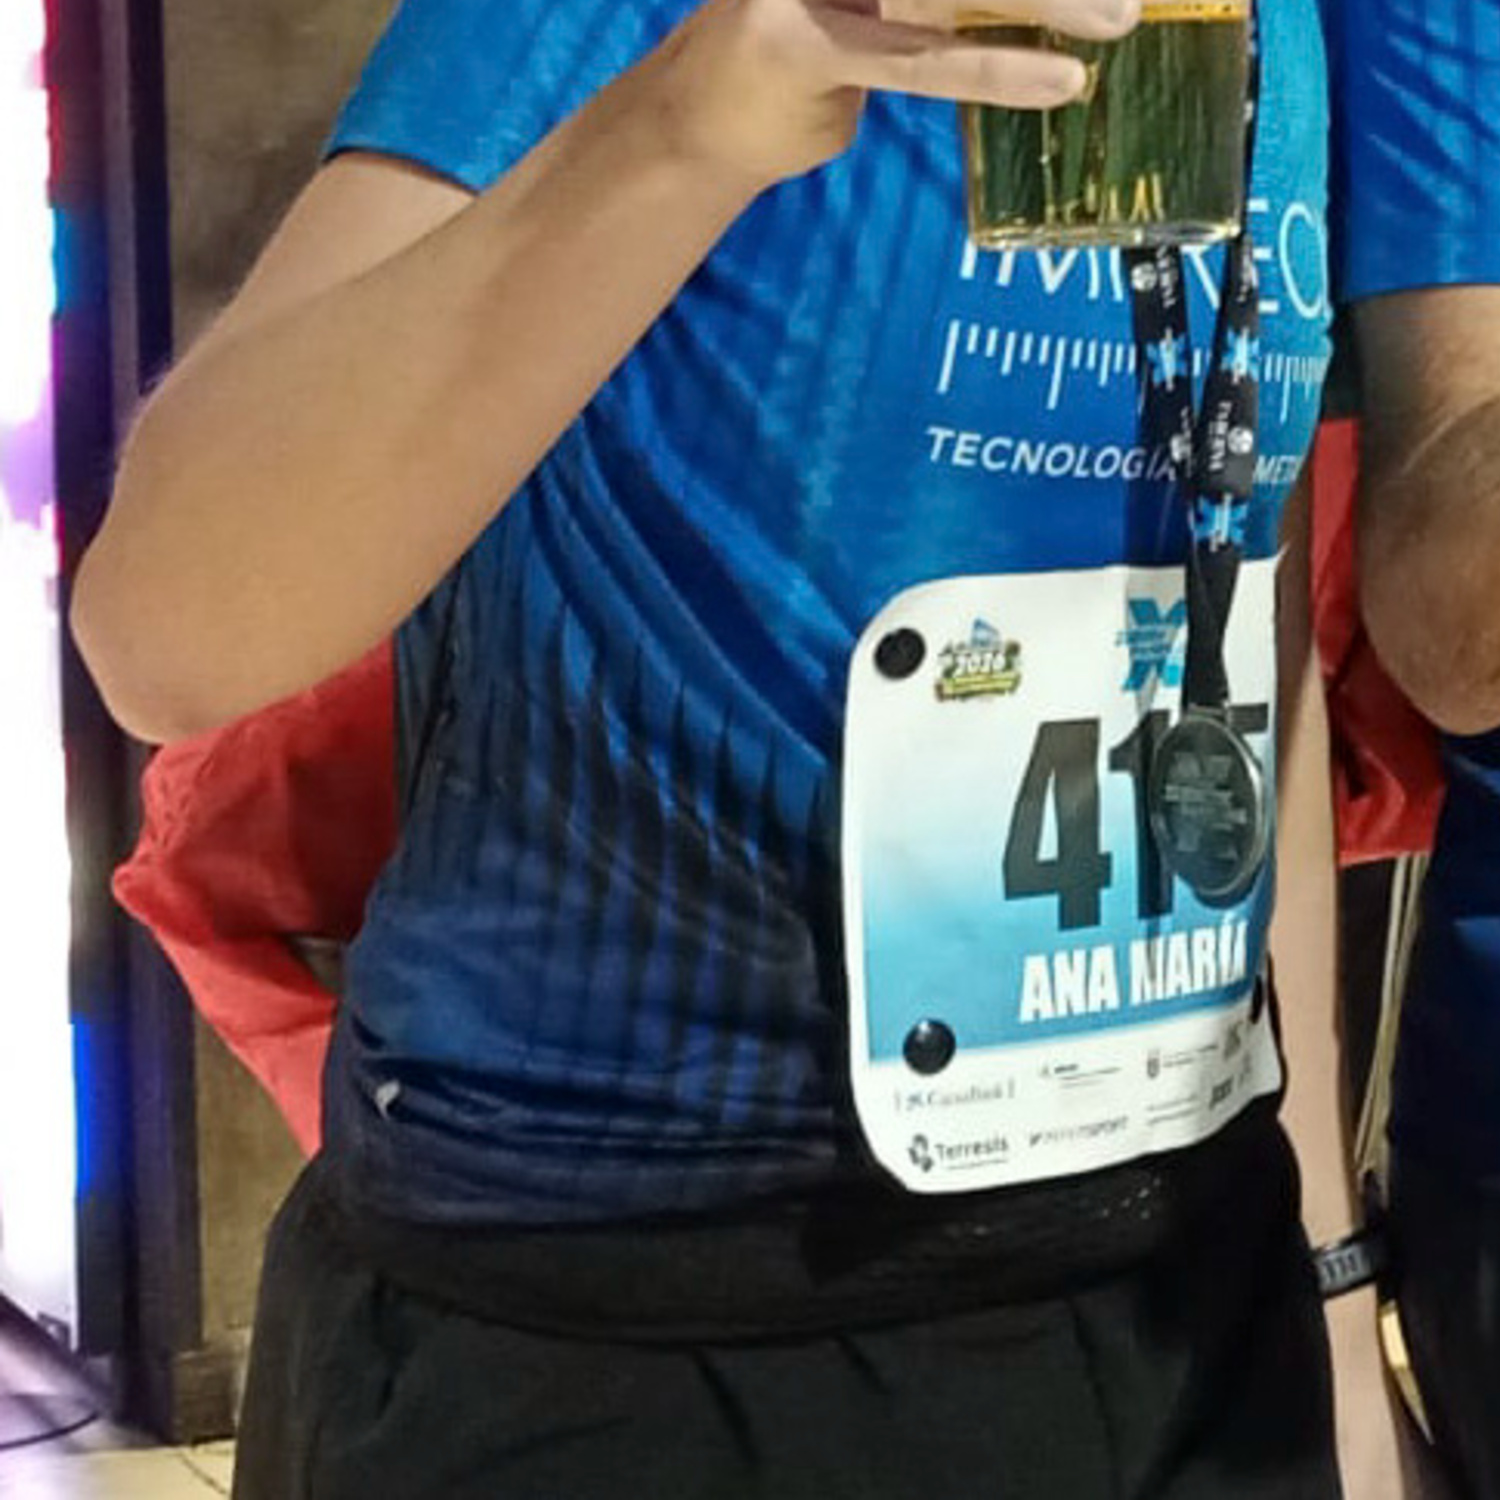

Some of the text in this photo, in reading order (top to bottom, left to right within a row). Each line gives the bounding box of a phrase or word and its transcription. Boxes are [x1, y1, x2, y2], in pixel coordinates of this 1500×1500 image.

[926, 426, 1177, 482] TECNOLOGÍA
[1002, 704, 1269, 932] 41
[1018, 912, 1249, 1024] ANA MARÍA
